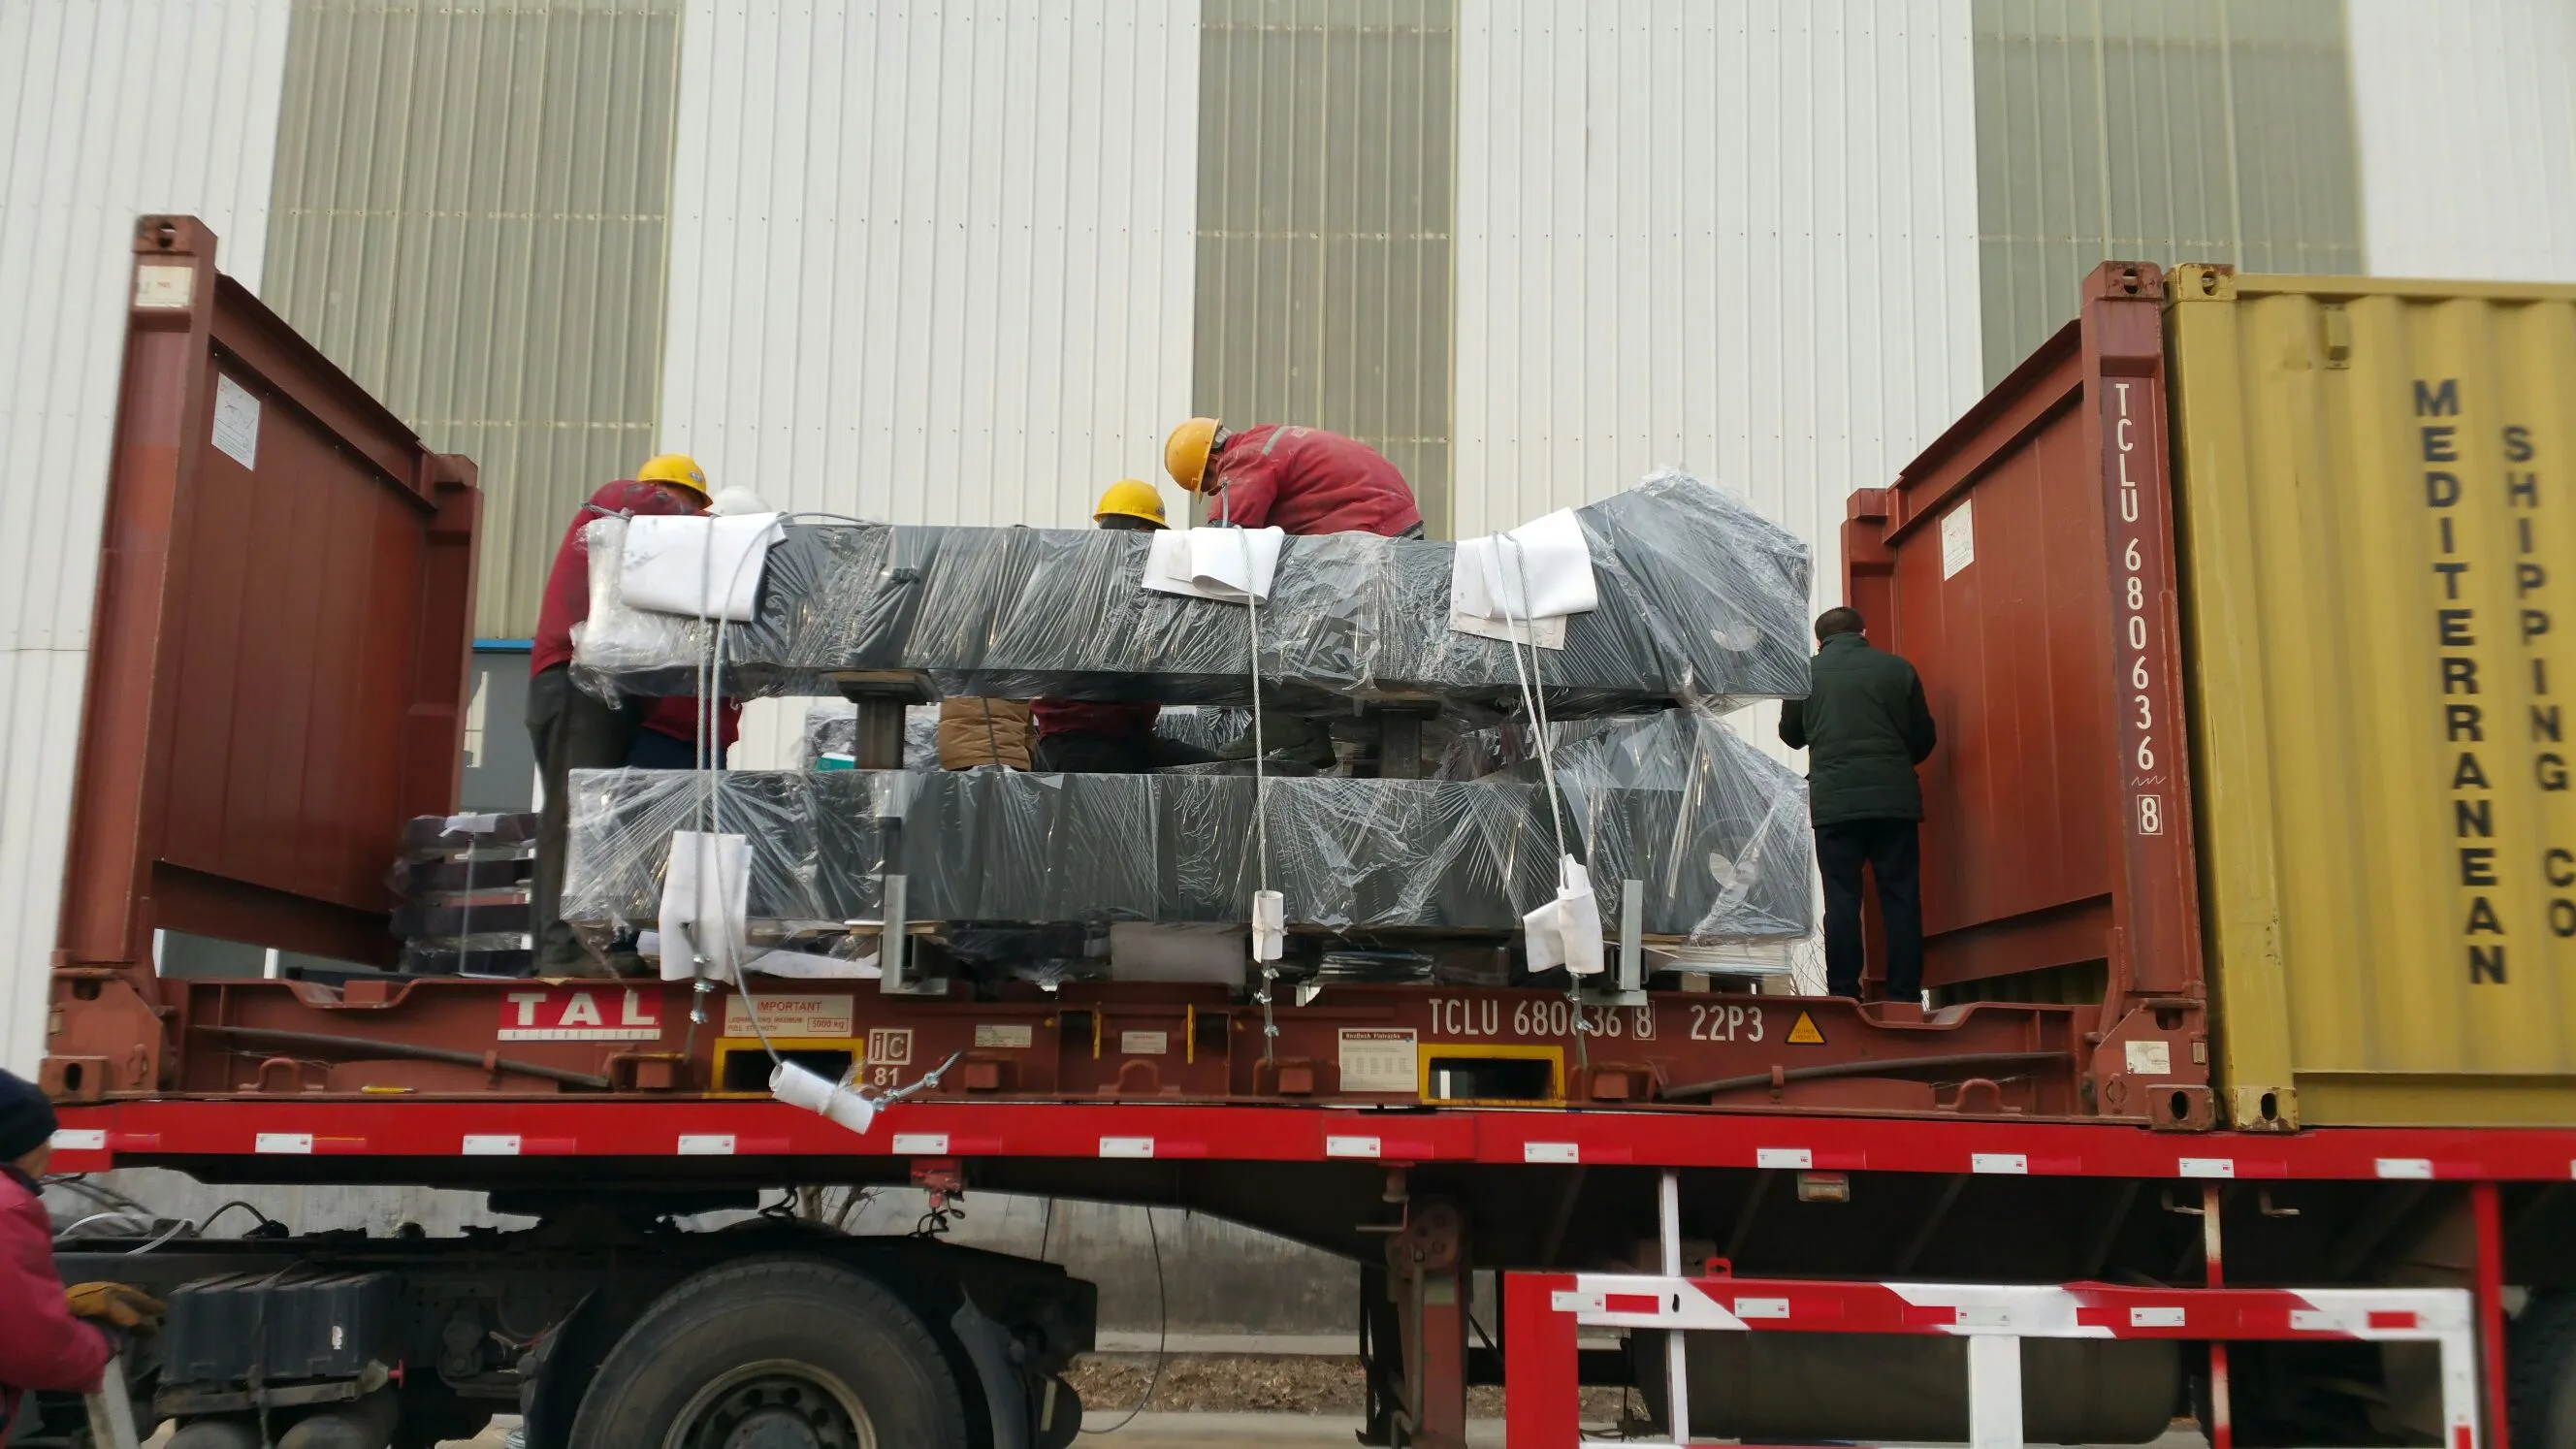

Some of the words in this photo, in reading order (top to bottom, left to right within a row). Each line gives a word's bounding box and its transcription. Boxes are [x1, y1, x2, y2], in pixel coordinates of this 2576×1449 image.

[2115, 383, 2140, 523] TCLU
[2125, 537, 2155, 771] 680636
[2413, 378, 2508, 985] MEDITERRANEAN
[2502, 425, 2570, 791] SHIPPING
[2544, 848, 2576, 938] CO
[2141, 797, 2159, 833] 8
[507, 992, 655, 1025] TAL
[757, 1001, 822, 1012] IMPORTANT
[1429, 999, 1498, 1035] TCLU
[1514, 1000, 1622, 1037] 68036
[1636, 1003, 1652, 1037] 8
[1690, 1005, 1764, 1042] 22P3
[874, 1068, 898, 1085] 81
